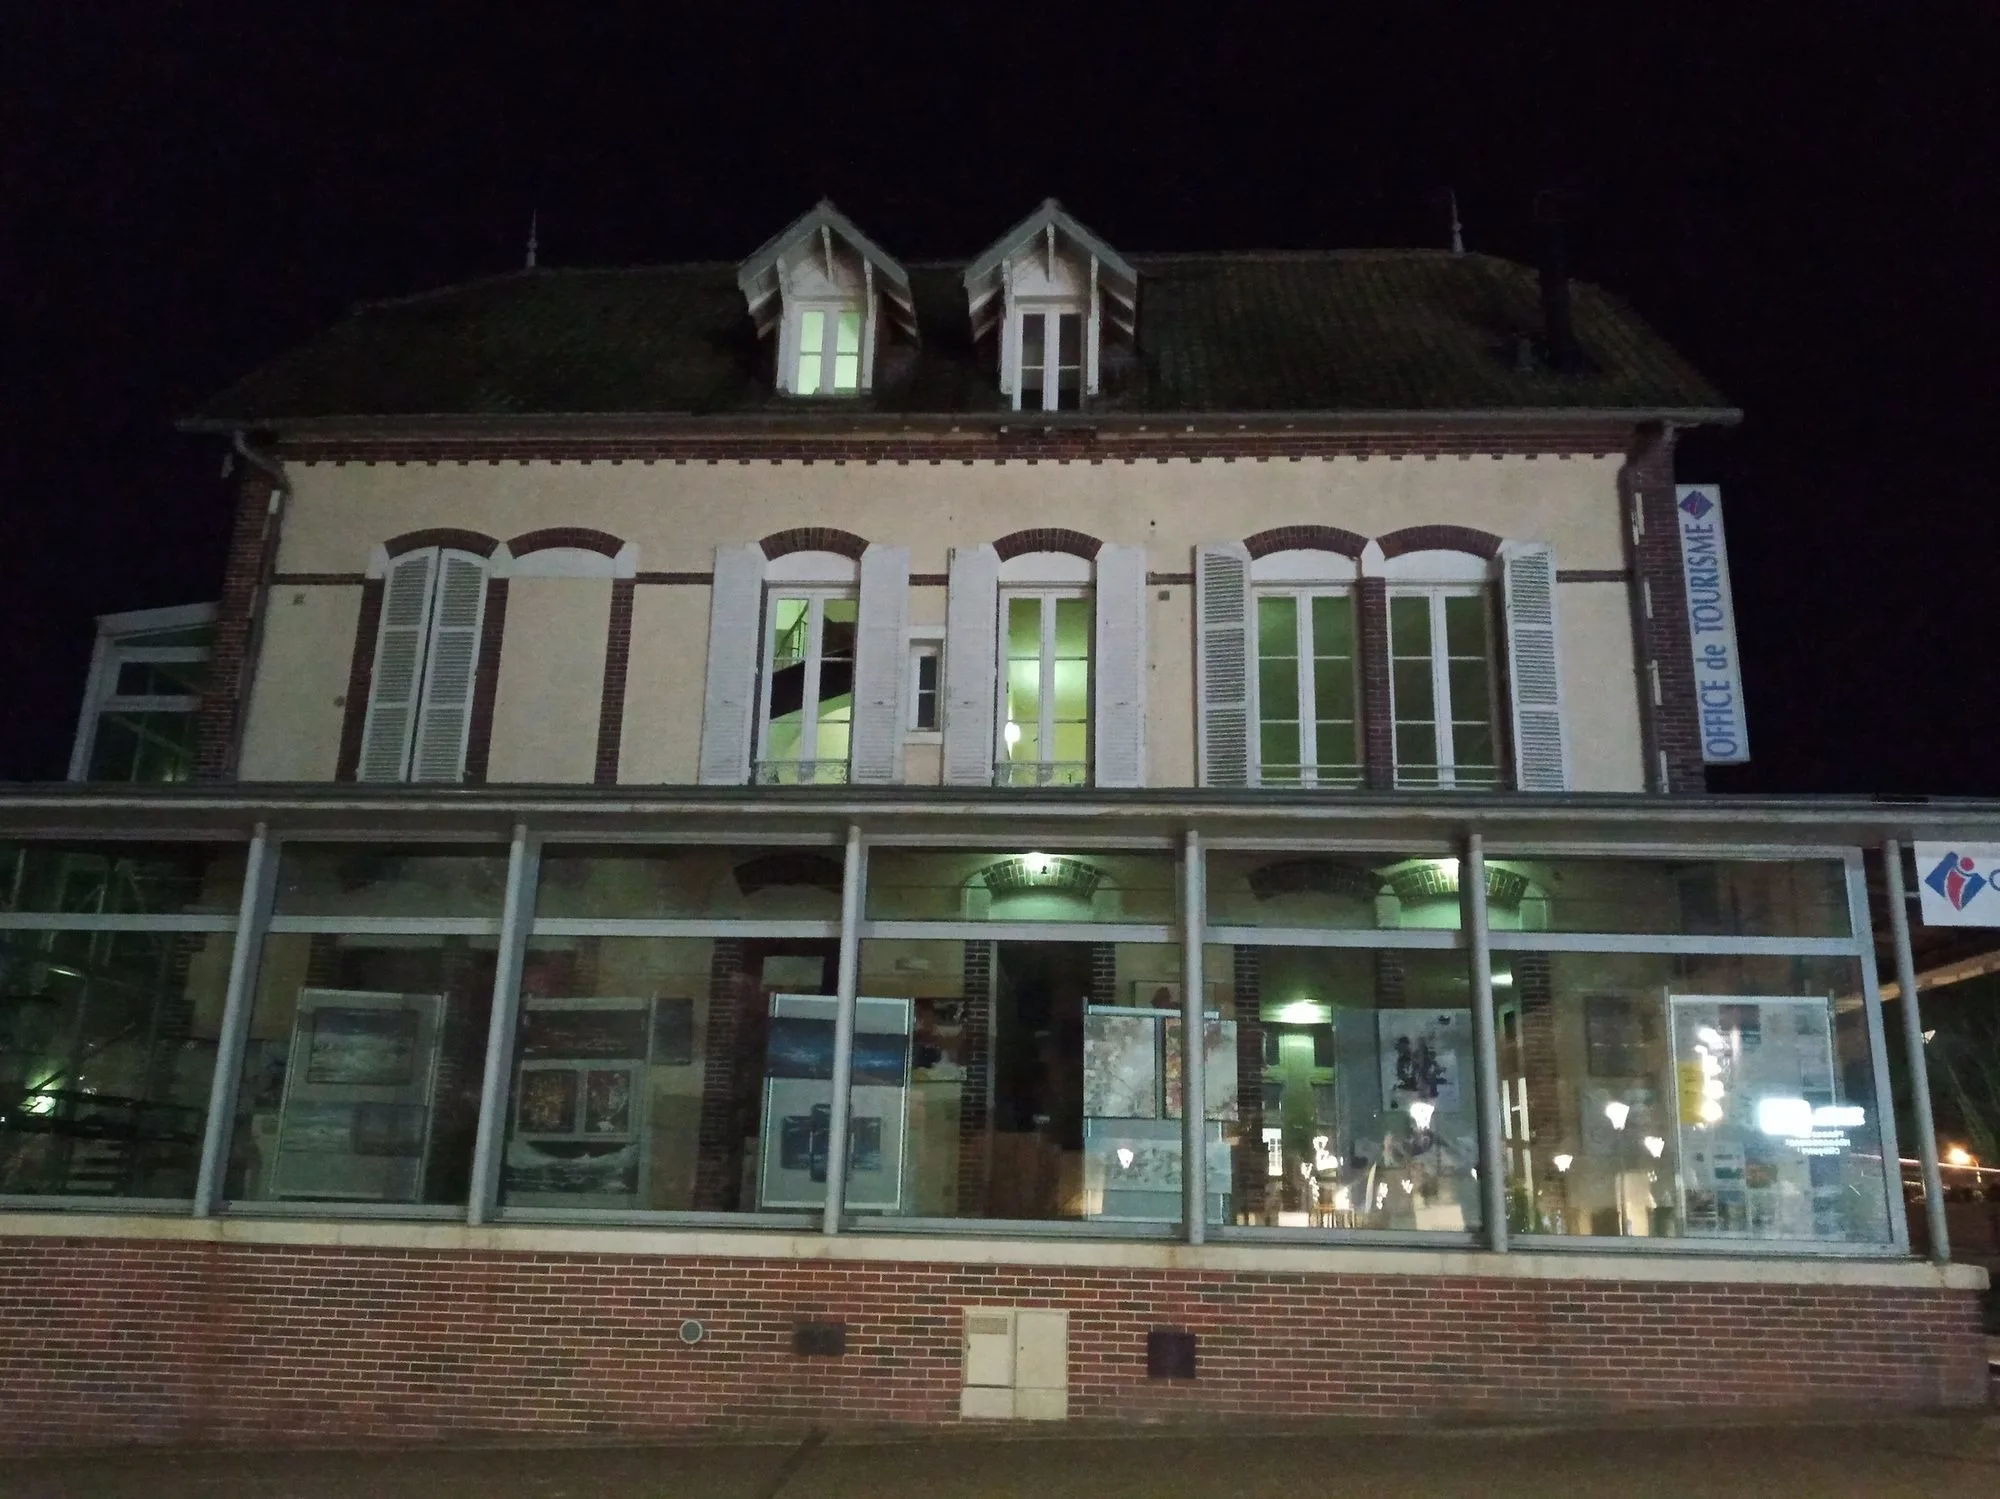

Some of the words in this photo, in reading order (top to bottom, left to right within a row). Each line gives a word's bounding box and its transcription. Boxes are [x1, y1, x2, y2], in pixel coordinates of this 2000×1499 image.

[1685, 523, 1724, 635] TOURISME
[1695, 644, 1728, 670] de
[1700, 680, 1738, 758] OFFICE
